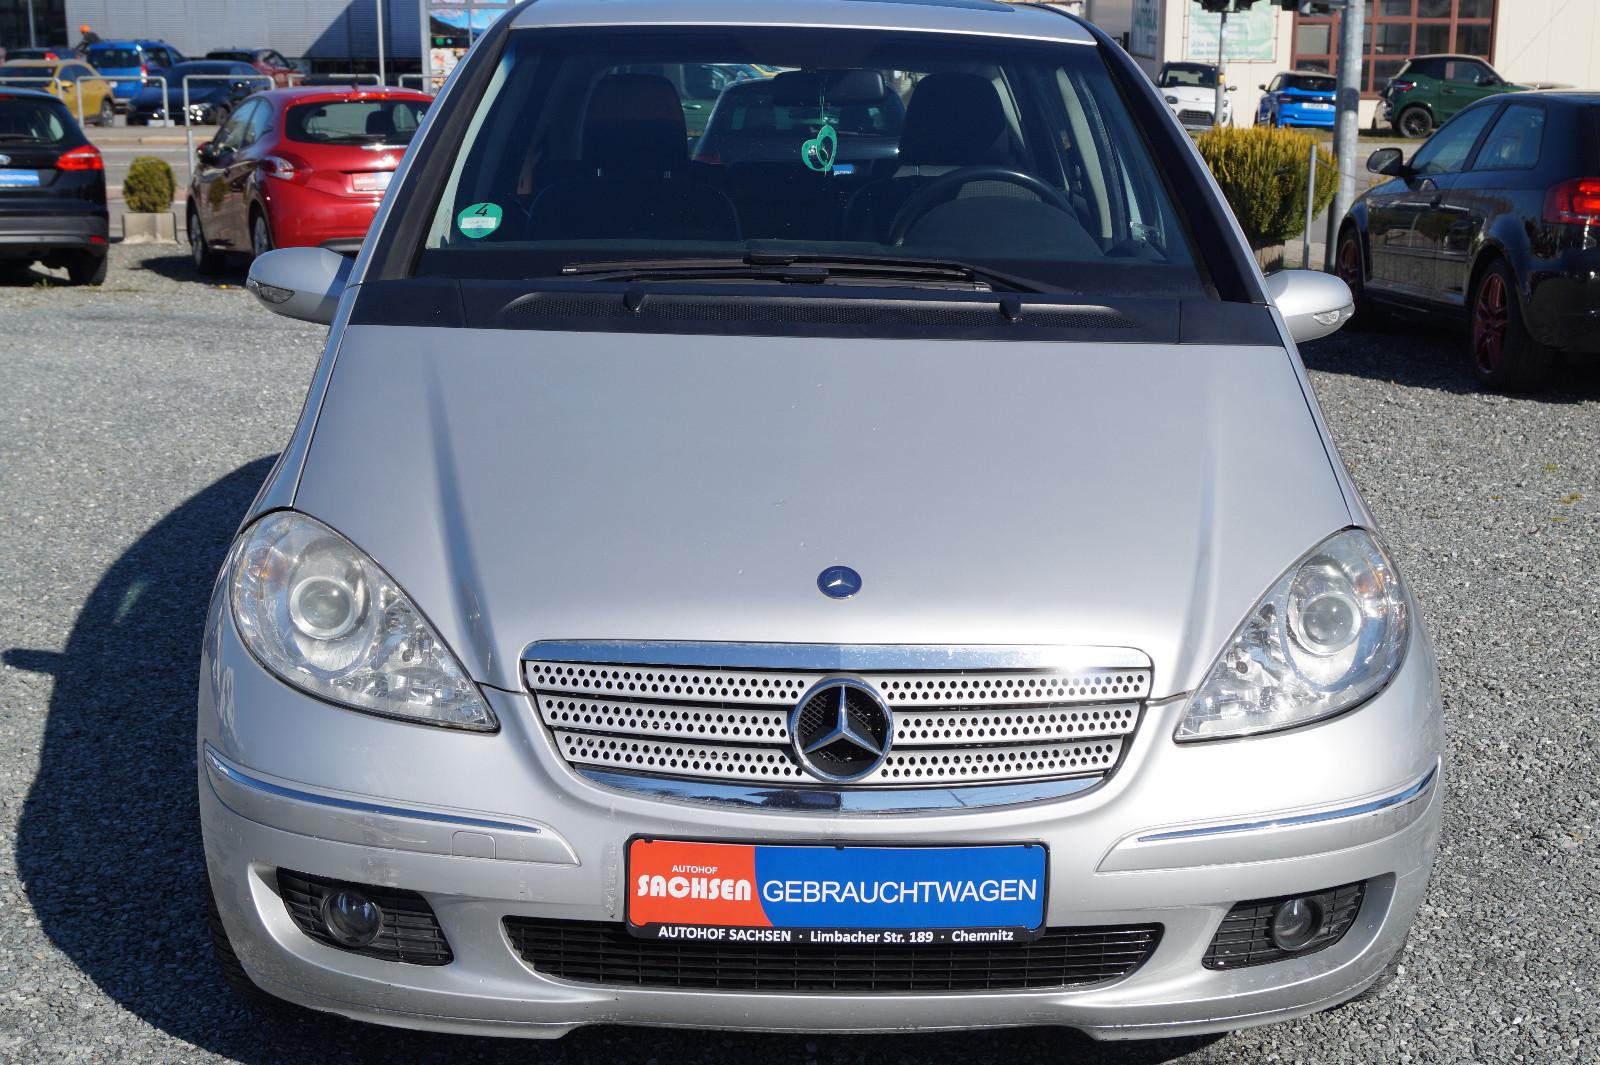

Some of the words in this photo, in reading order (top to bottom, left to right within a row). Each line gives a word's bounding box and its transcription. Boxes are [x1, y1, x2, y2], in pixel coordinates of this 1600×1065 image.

[474, 203, 489, 217] 4
[671, 864, 718, 875] AUTOHOF
[637, 874, 752, 901] SACHSEN
[762, 879, 1037, 904] GEBRAUCHTWAGEN
[658, 925, 726, 940] AUTOHOF
[728, 928, 792, 942] SACHSEN
[810, 930, 881, 943] Limbacher
[883, 931, 905, 943] Str.
[909, 931, 934, 943] 189
[951, 929, 1014, 942] Chemnitz
